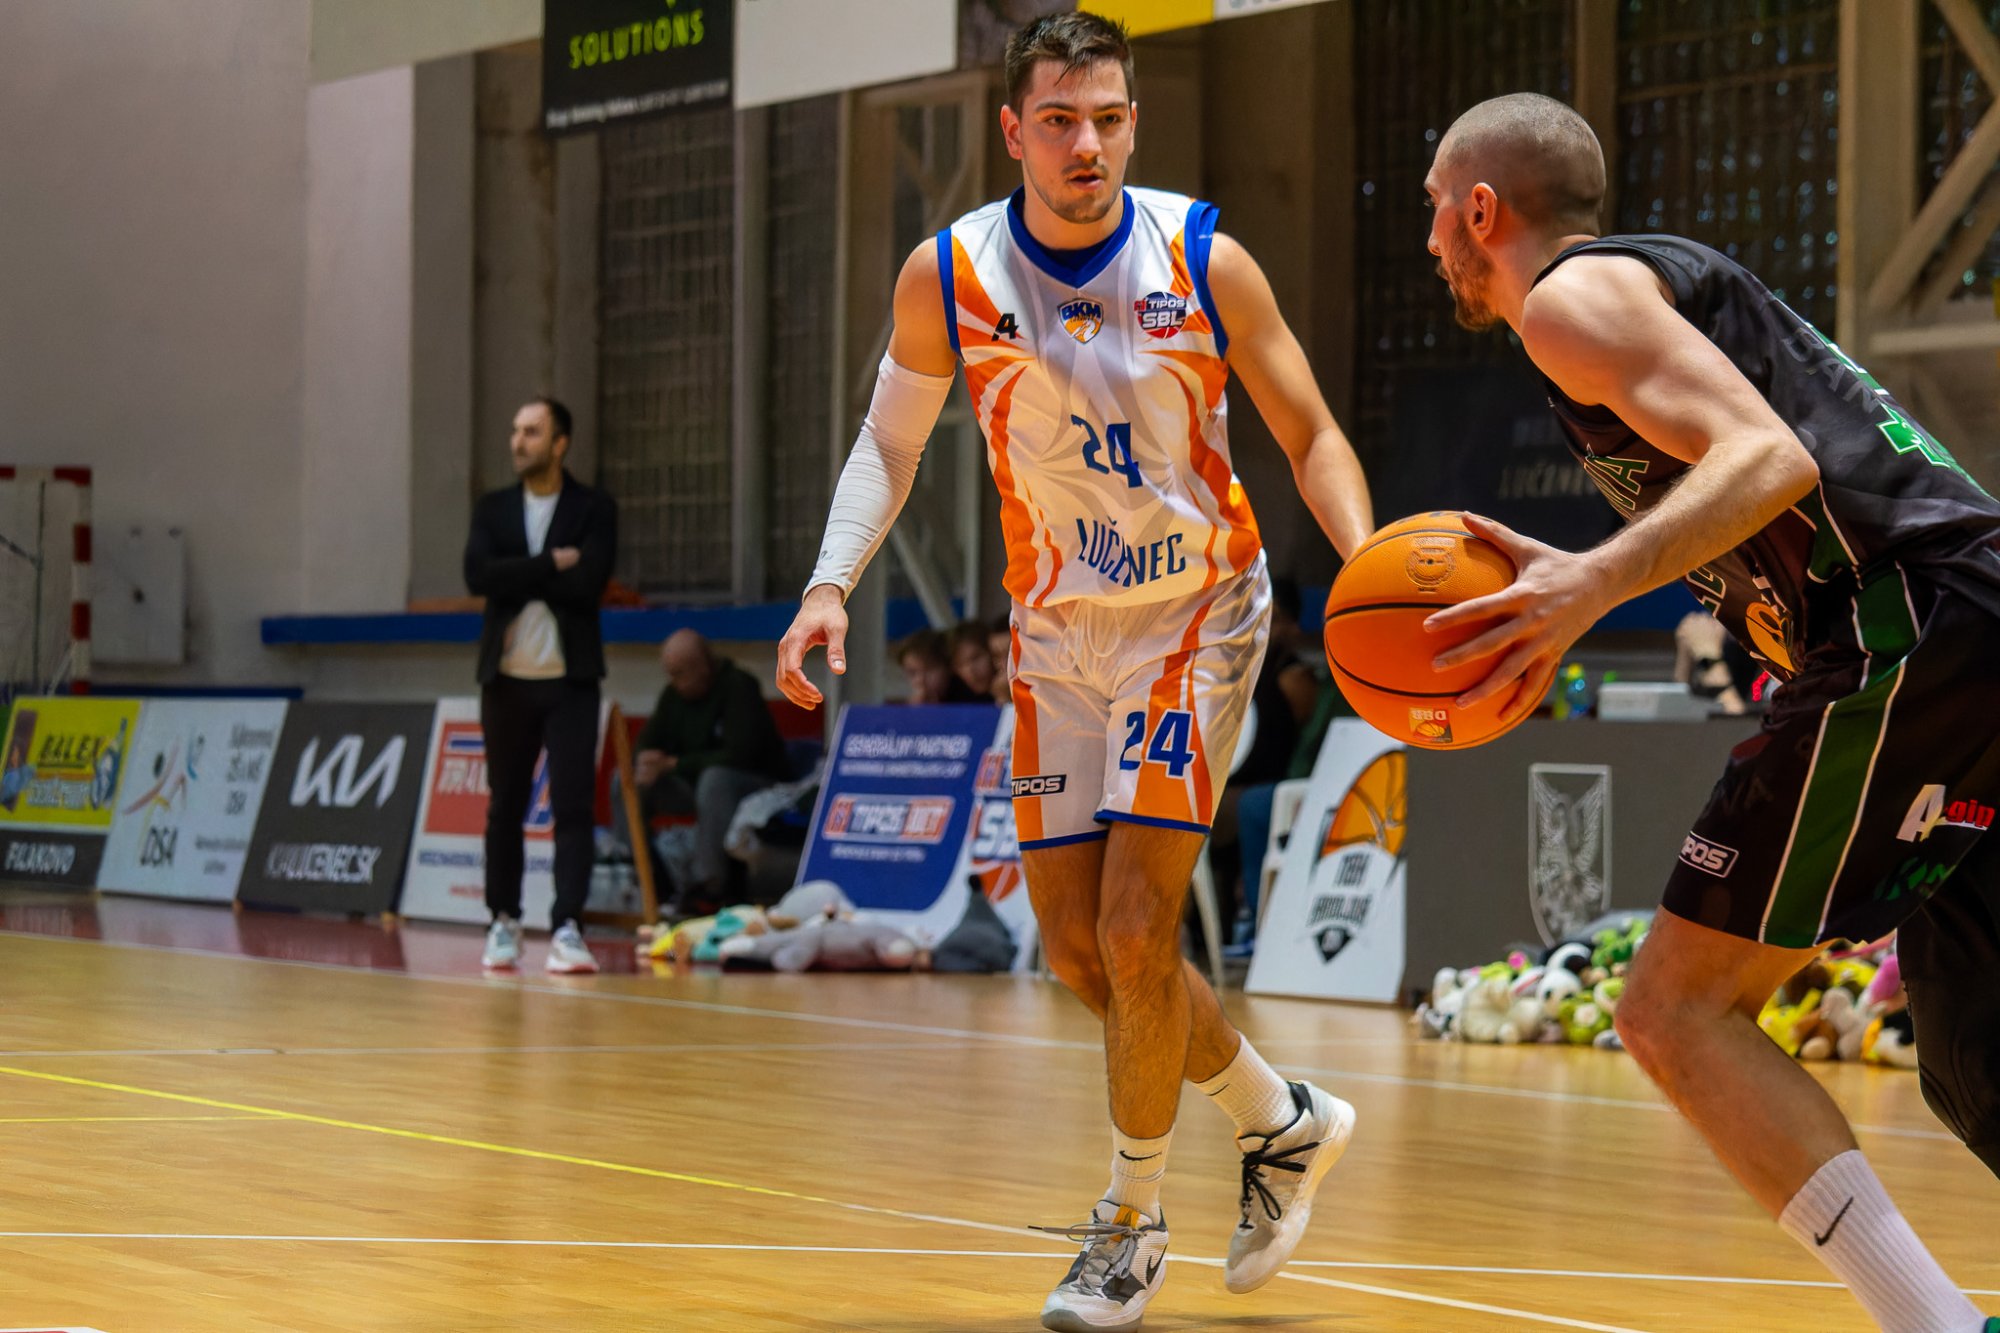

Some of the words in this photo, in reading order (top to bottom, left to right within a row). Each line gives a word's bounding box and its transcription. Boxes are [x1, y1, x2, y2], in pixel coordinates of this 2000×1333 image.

[569, 9, 705, 69] SOLUTIONS
[1061, 301, 1102, 320] BKM
[1142, 310, 1183, 328] SBL
[1148, 299, 1186, 309] TIPOS
[1071, 414, 1143, 488] 24
[1075, 515, 1186, 588] LUČENEC
[1119, 709, 1194, 778] 24
